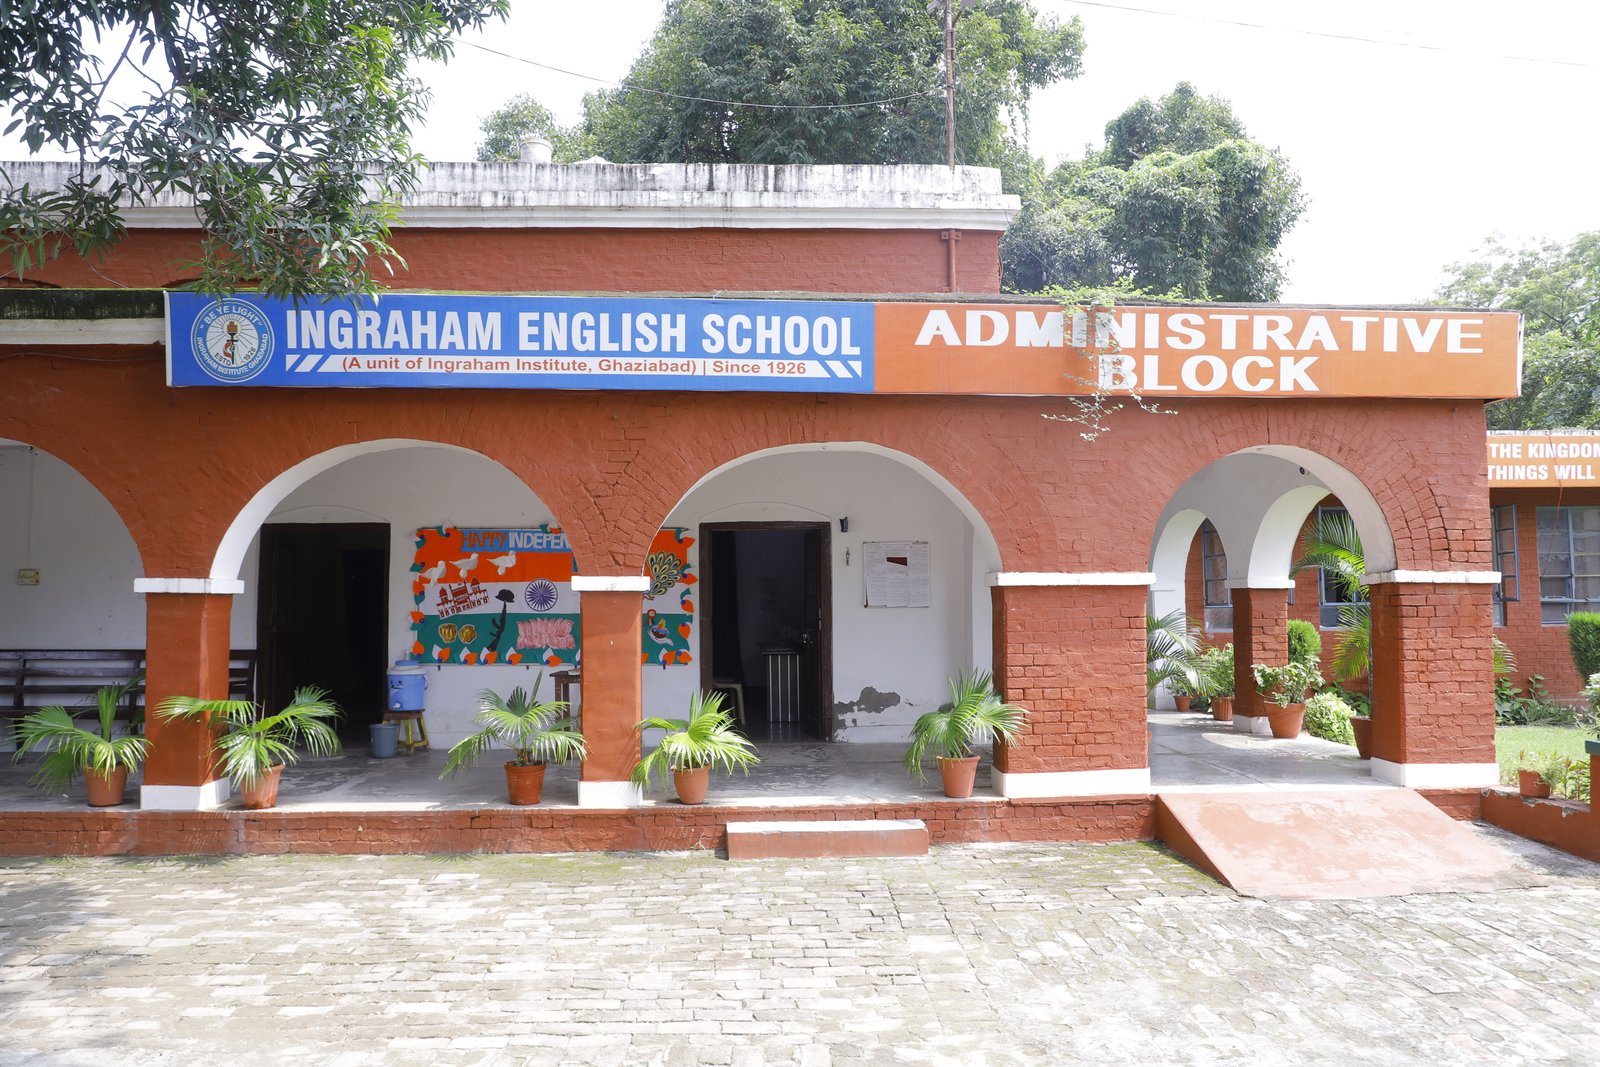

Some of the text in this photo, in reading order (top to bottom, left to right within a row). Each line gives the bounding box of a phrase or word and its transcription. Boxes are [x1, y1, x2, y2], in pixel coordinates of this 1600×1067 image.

[216, 305, 230, 315] YE
[286, 309, 861, 356] INGRAHAM ENGLISH SCHOOL
[914, 310, 1484, 354] ADMINISTRATIVE
[197, 333, 268, 375] INGRAHAM INSTITUTE GHAZIABAD
[243, 346, 256, 361] 1926
[342, 356, 361, 372] (A
[366, 357, 400, 370] unit
[405, 357, 423, 370] of
[428, 357, 510, 373] Ingraham
[516, 358, 593, 374] Institute,
[598, 358, 697, 376] Ghaziabad)
[712, 360, 761, 374] Since
[767, 361, 807, 375] 1926
[1098, 354, 1321, 392] BLOCK
[1488, 443, 1522, 458] THE
[1487, 464, 1596, 480] THINGS WILL
[460, 532, 507, 548] HAPPY
